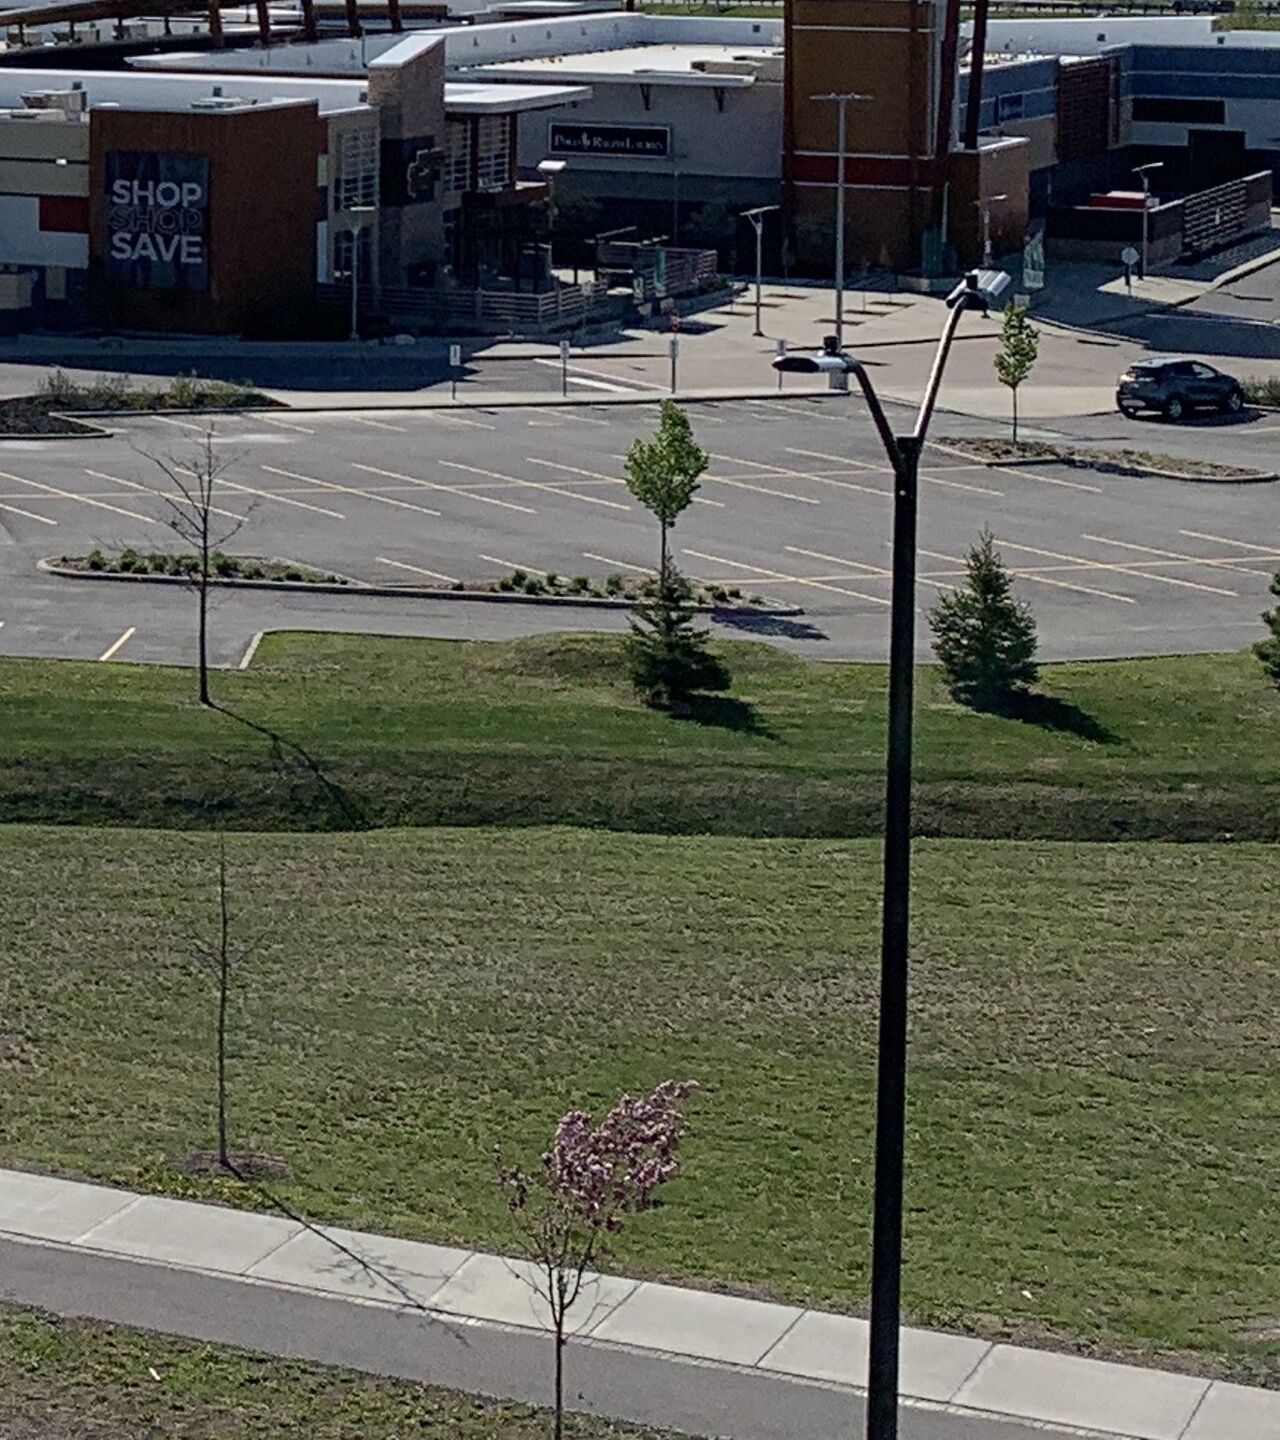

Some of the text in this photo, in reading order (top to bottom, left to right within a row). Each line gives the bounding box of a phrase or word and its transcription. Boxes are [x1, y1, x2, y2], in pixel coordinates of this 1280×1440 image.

[111, 179, 202, 208] SHOP
[110, 205, 202, 235] SHOP
[110, 232, 203, 264] SAVE
